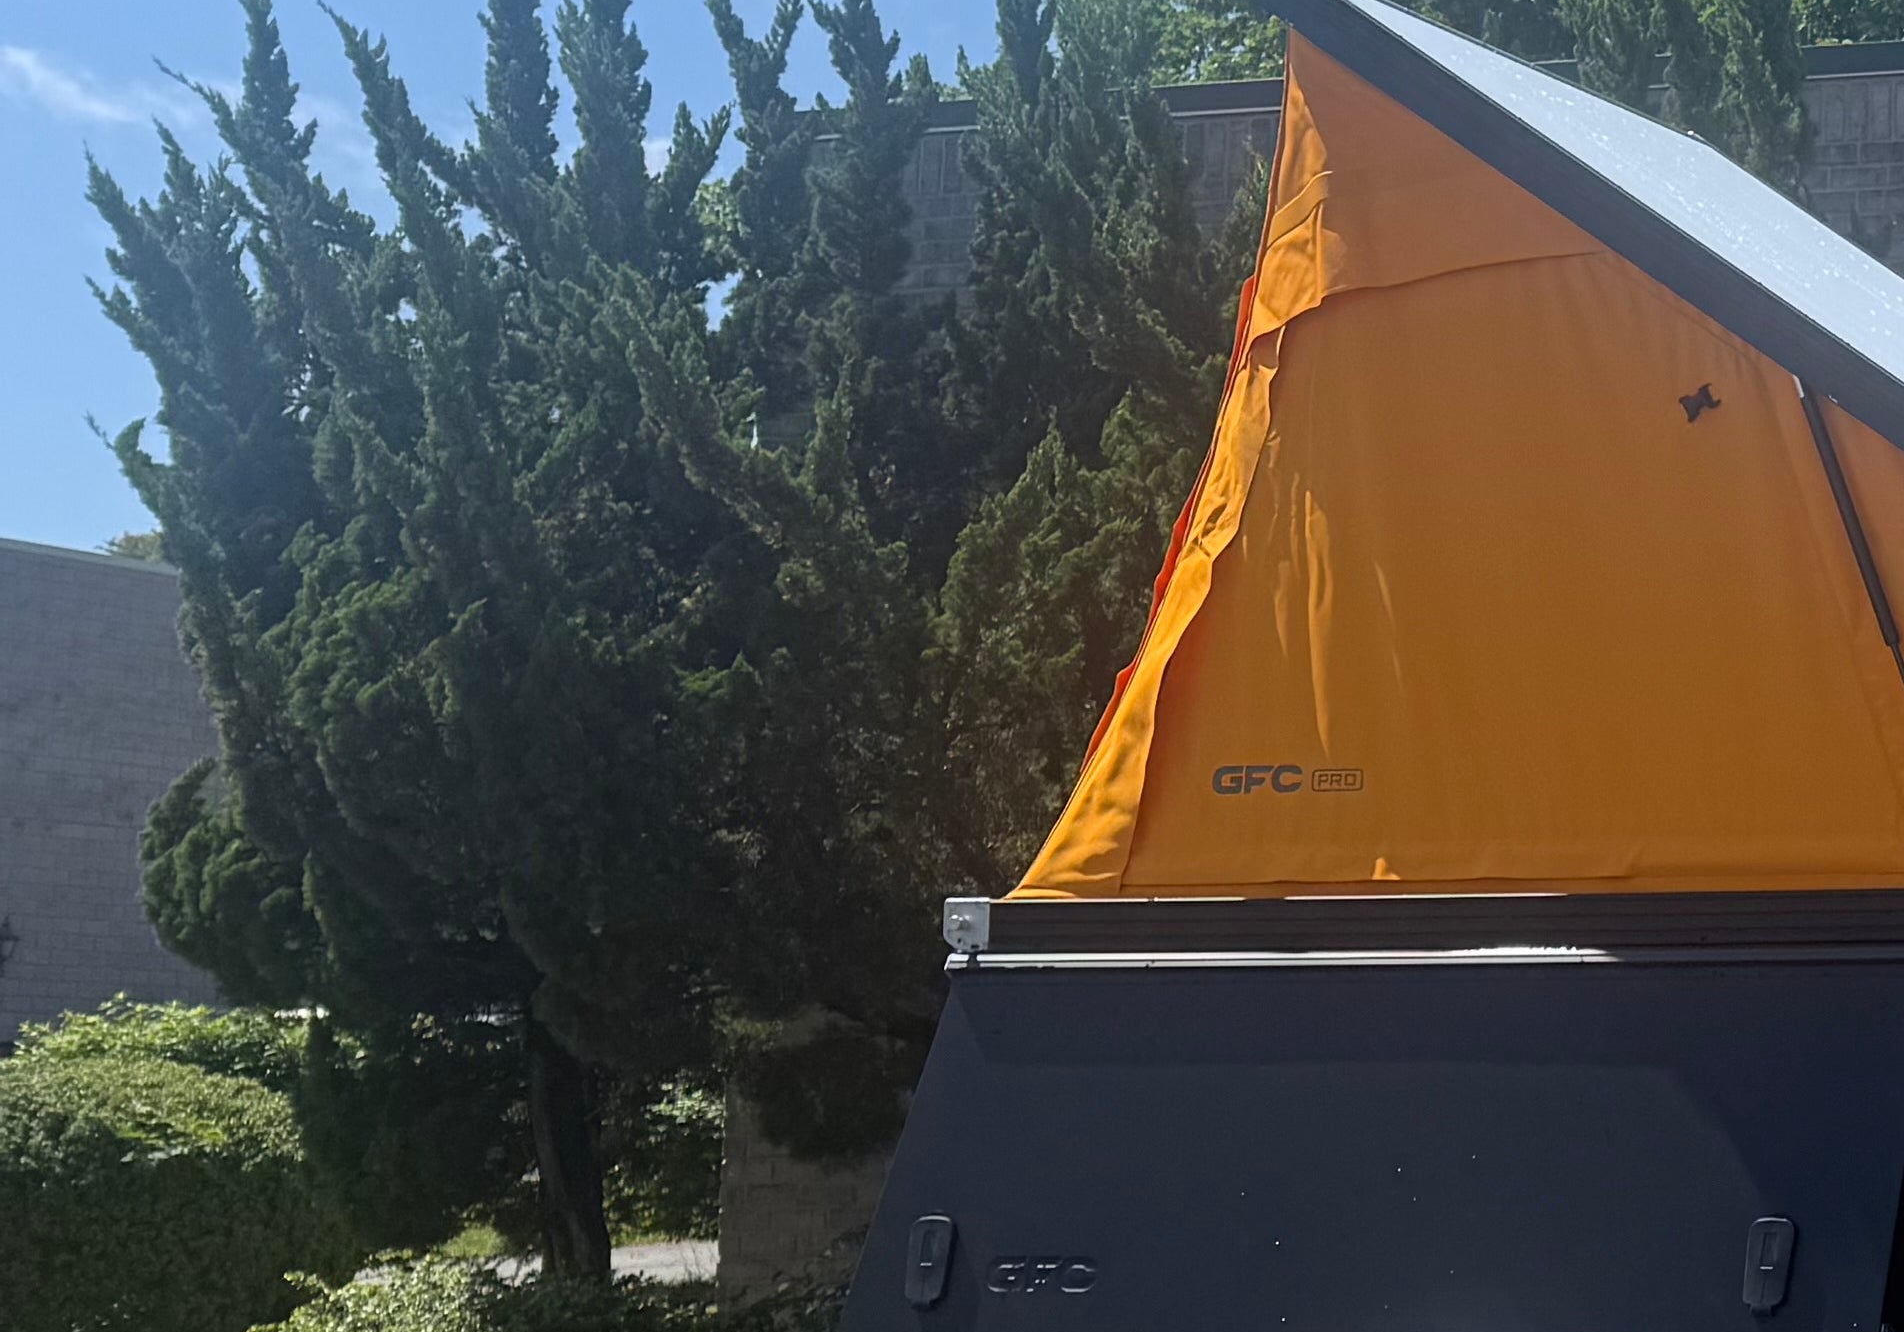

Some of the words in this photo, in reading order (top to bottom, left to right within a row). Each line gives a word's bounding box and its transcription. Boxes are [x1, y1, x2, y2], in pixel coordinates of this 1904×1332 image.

[1212, 764, 1303, 795] GFC
[1316, 772, 1358, 788] PRO
[987, 1255, 1098, 1293] GFC
